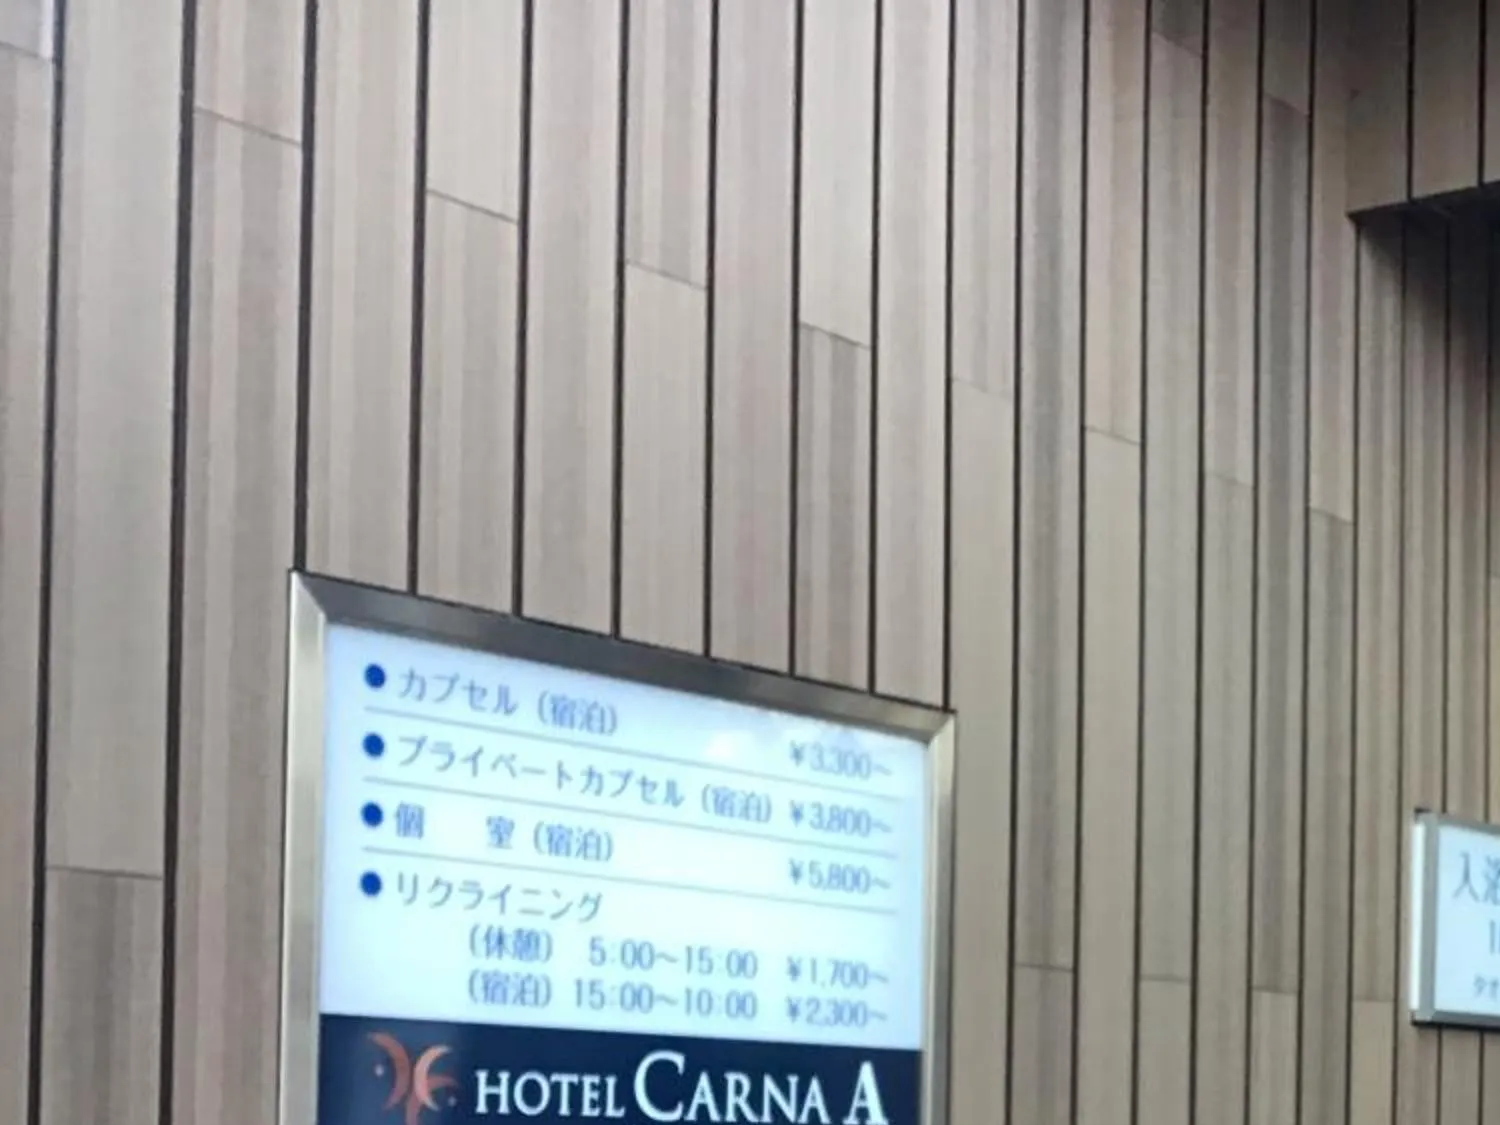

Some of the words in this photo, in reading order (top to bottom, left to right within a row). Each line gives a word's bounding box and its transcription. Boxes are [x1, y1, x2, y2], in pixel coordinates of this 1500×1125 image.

[397, 871, 602, 923] リクライニング
[475, 1069, 626, 1118] HOTEL
[633, 1051, 830, 1125] CARNA
